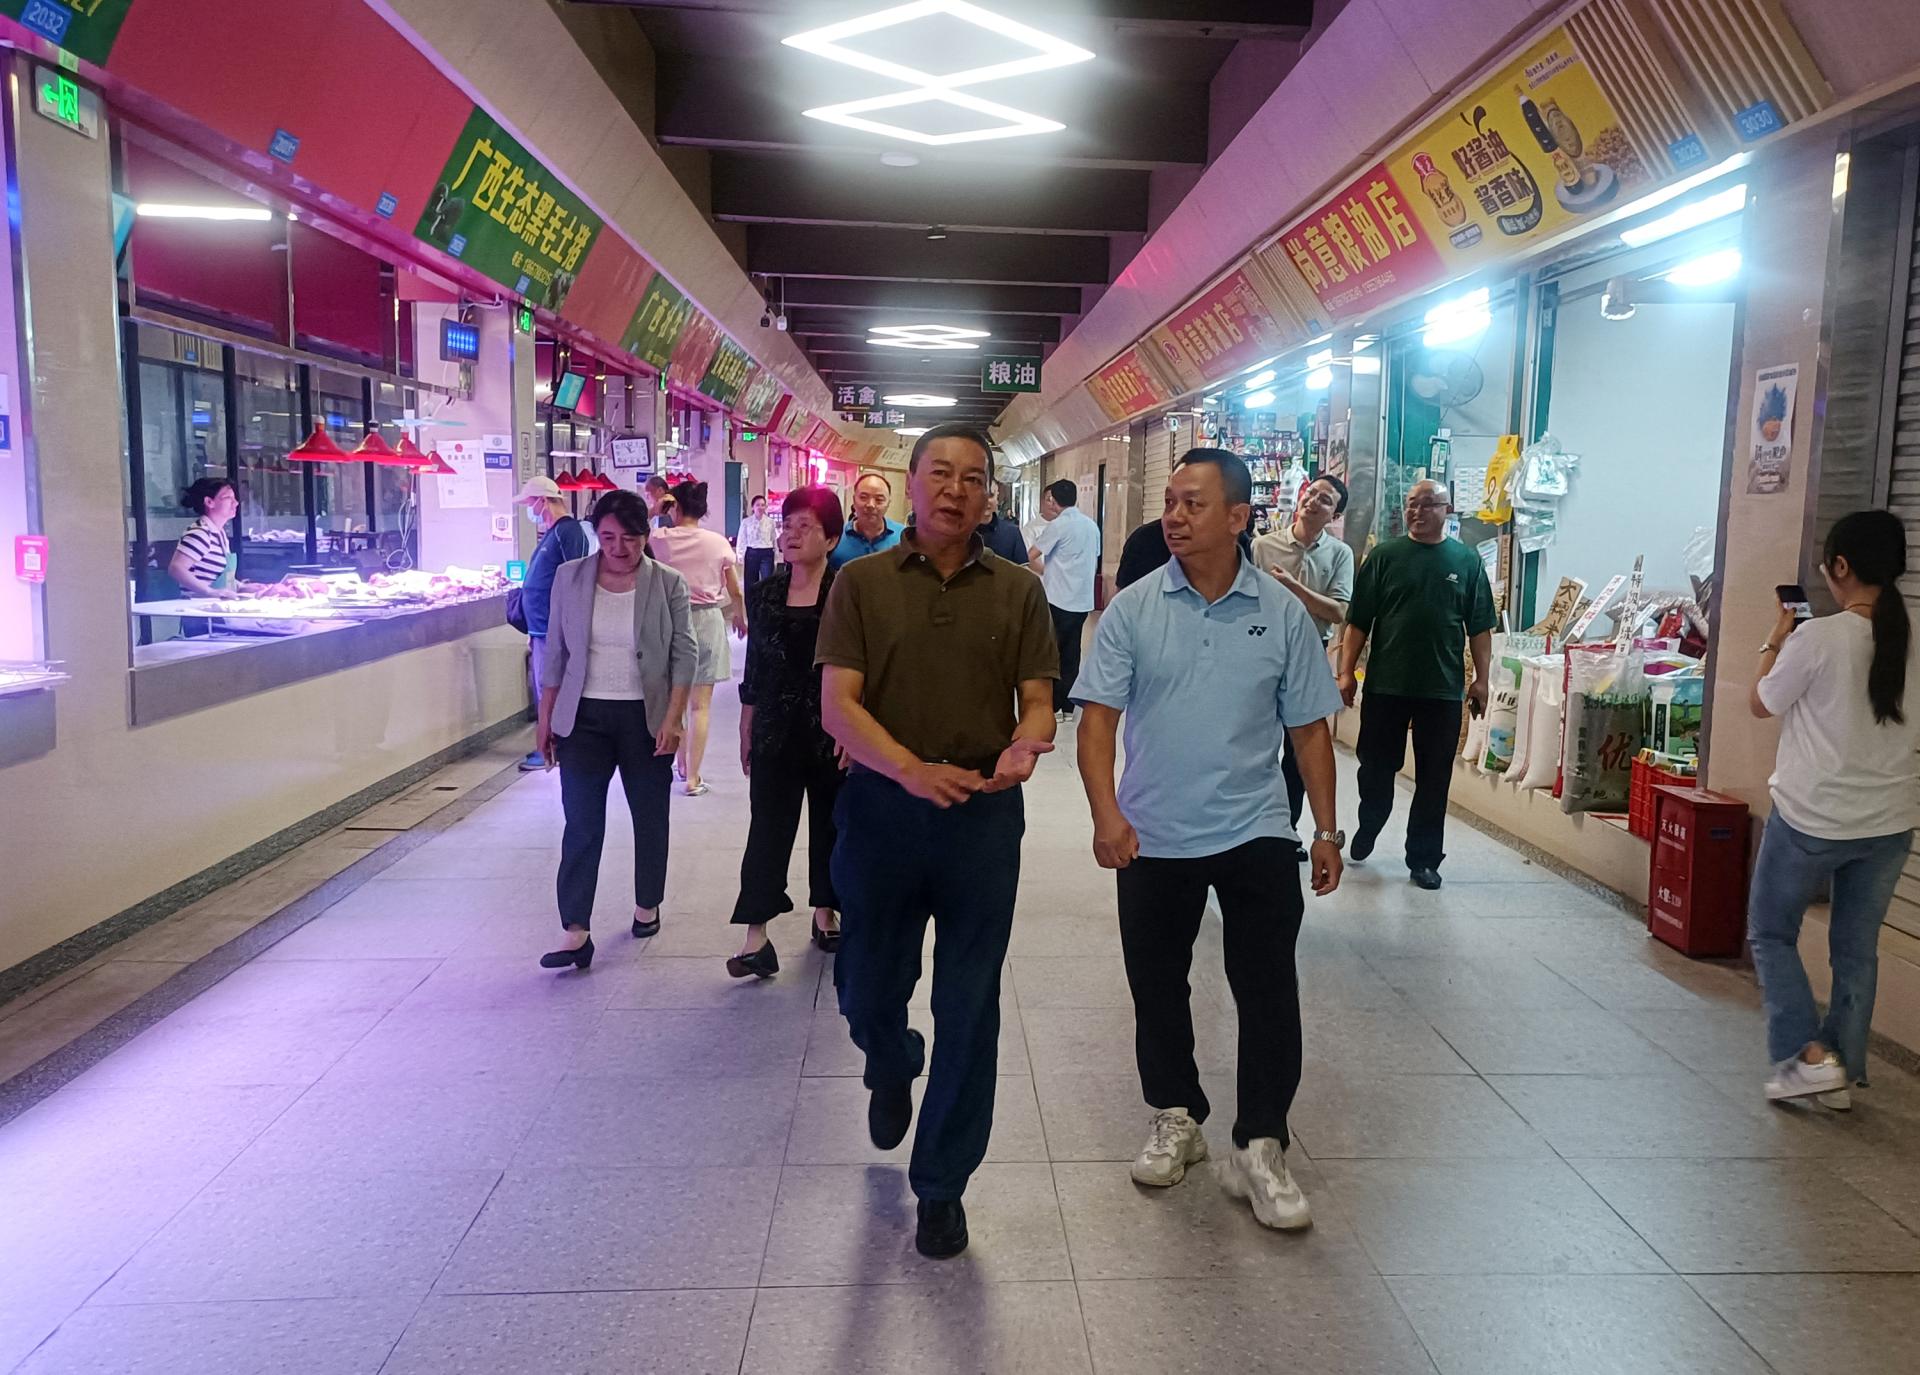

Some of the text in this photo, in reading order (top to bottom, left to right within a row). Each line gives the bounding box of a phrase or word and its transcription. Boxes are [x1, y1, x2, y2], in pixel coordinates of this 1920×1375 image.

[28, 1, 64, 35] 2032
[1741, 109, 1774, 135] 3030
[1451, 128, 1510, 180] 好酱油
[451, 138, 592, 271] 广西生态黑毛土猪
[1474, 167, 1534, 215] 酱香味
[1286, 181, 1417, 293] 尚意粮油店
[838, 386, 877, 405] 活禽
[988, 361, 1036, 386] 粮油
[1545, 580, 1577, 636] 大糯米
